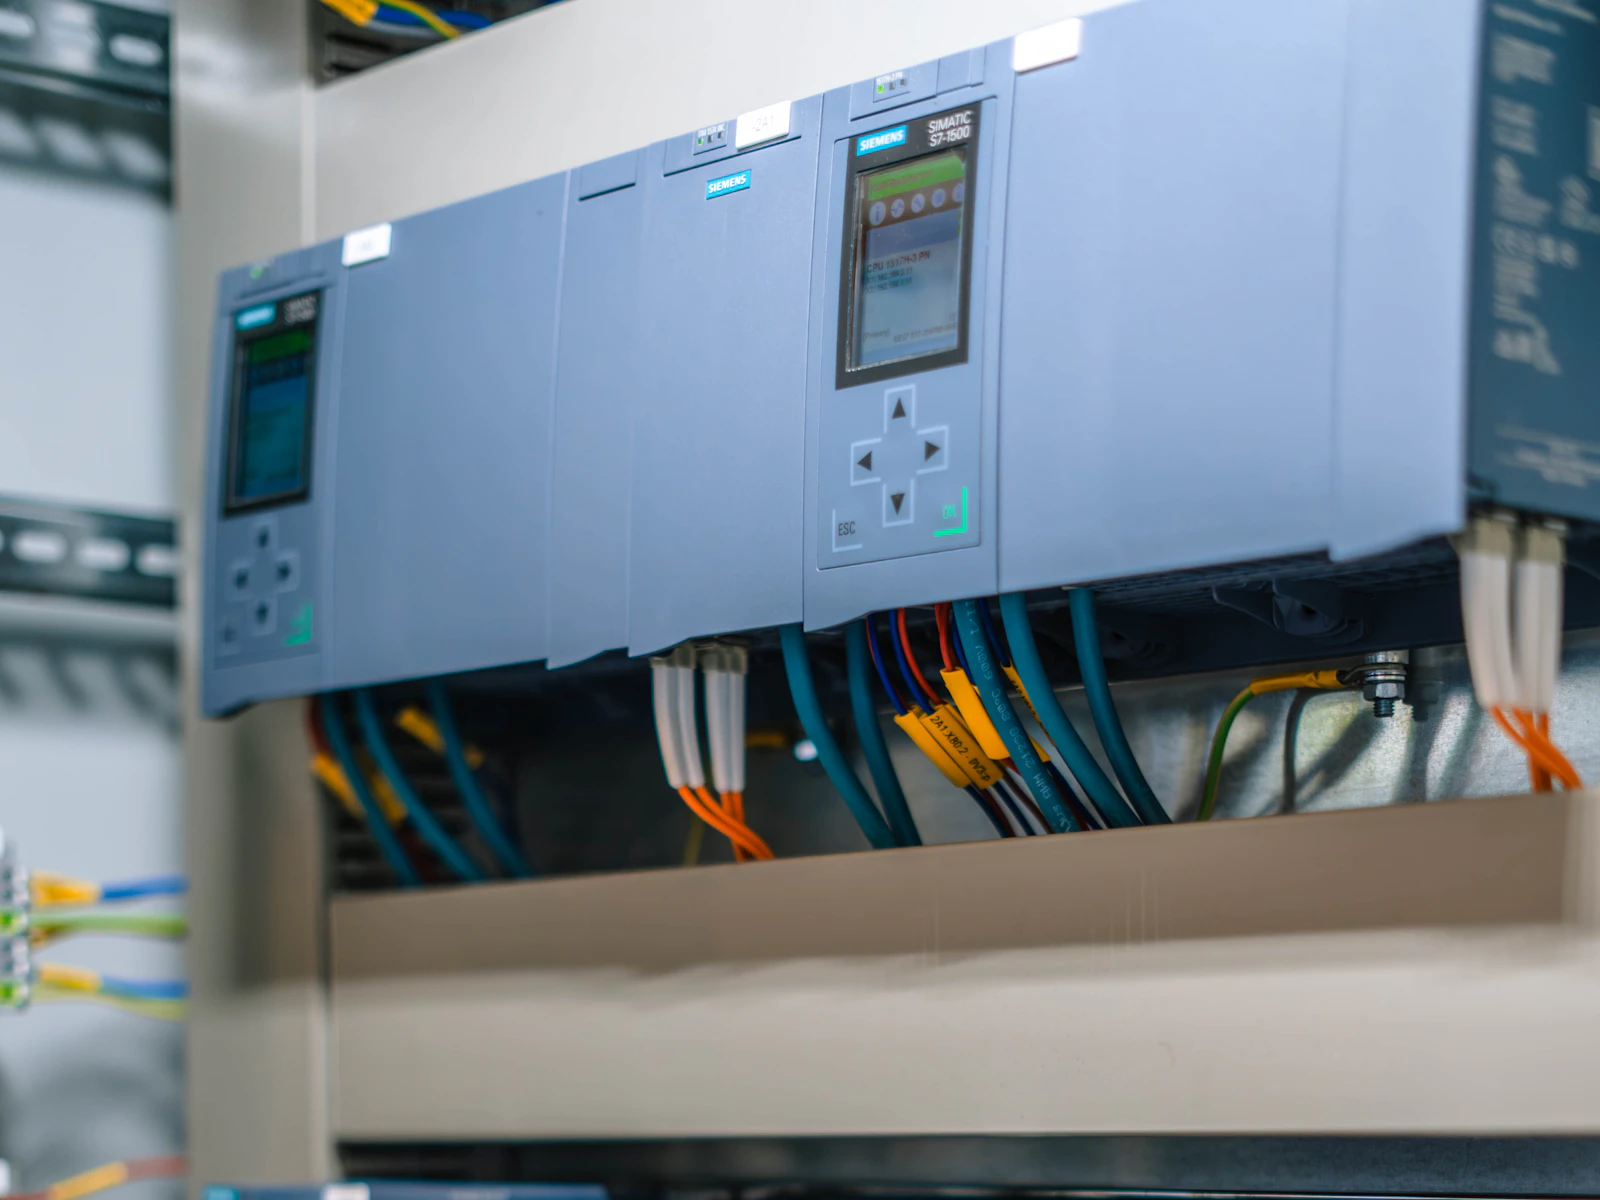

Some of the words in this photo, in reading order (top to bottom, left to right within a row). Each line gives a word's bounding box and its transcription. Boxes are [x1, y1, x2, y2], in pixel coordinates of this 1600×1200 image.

[928, 110, 972, 134] SIMATIC
[860, 130, 904, 152] SIEMENS
[929, 126, 970, 147] S7-1500
[708, 173, 747, 194] SIEMENS
[866, 260, 884, 274] CPU
[918, 250, 931, 261] PN
[942, 504, 957, 519] OK
[838, 521, 856, 537] ESC
[1033, 773, 1052, 799] AWM
